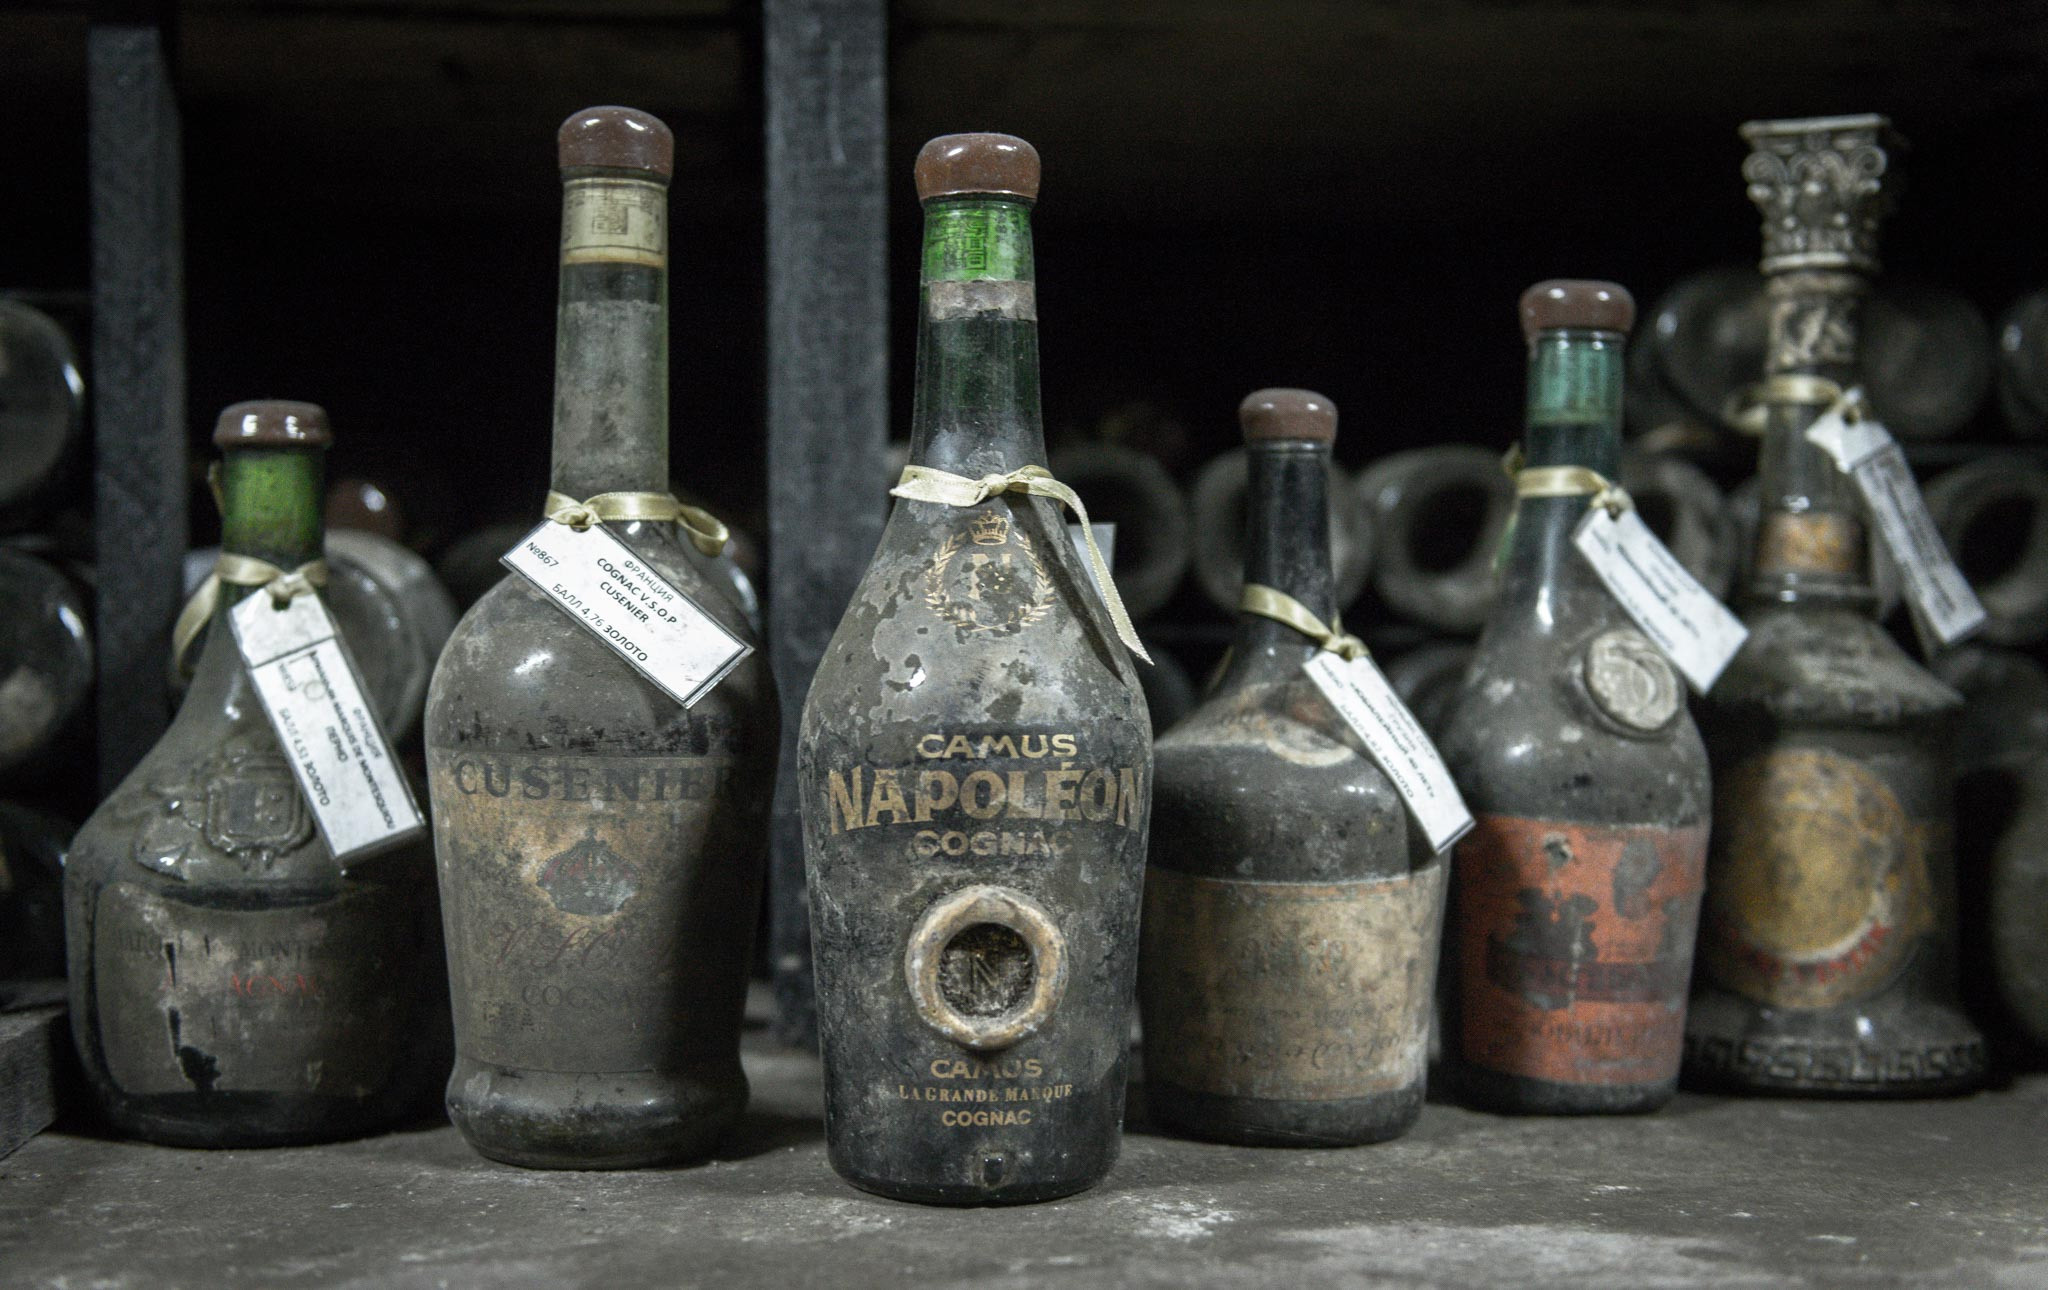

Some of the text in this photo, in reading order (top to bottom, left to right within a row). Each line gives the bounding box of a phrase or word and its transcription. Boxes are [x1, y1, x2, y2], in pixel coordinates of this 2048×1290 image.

[525, 541, 559, 568] №867
[596, 557, 640, 596] COGNAC
[623, 559, 675, 603] ФРАНЦИЯ
[551, 582, 582, 611] БАЛЛ
[602, 623, 649, 663] ЗОЛОТО
[599, 580, 650, 624] CUSENIER
[916, 733, 1078, 759] CAMUS
[302, 760, 331, 807] ЗОЛОТО
[1381, 754, 1416, 799] ЗОЛОТО
[829, 762, 1145, 835] NAPOLÉON
[912, 829, 1073, 857] COGNAC
[899, 1084, 920, 1100] LA
[925, 1087, 999, 1103] GRANDE
[942, 1109, 1031, 1127] COGNAC
